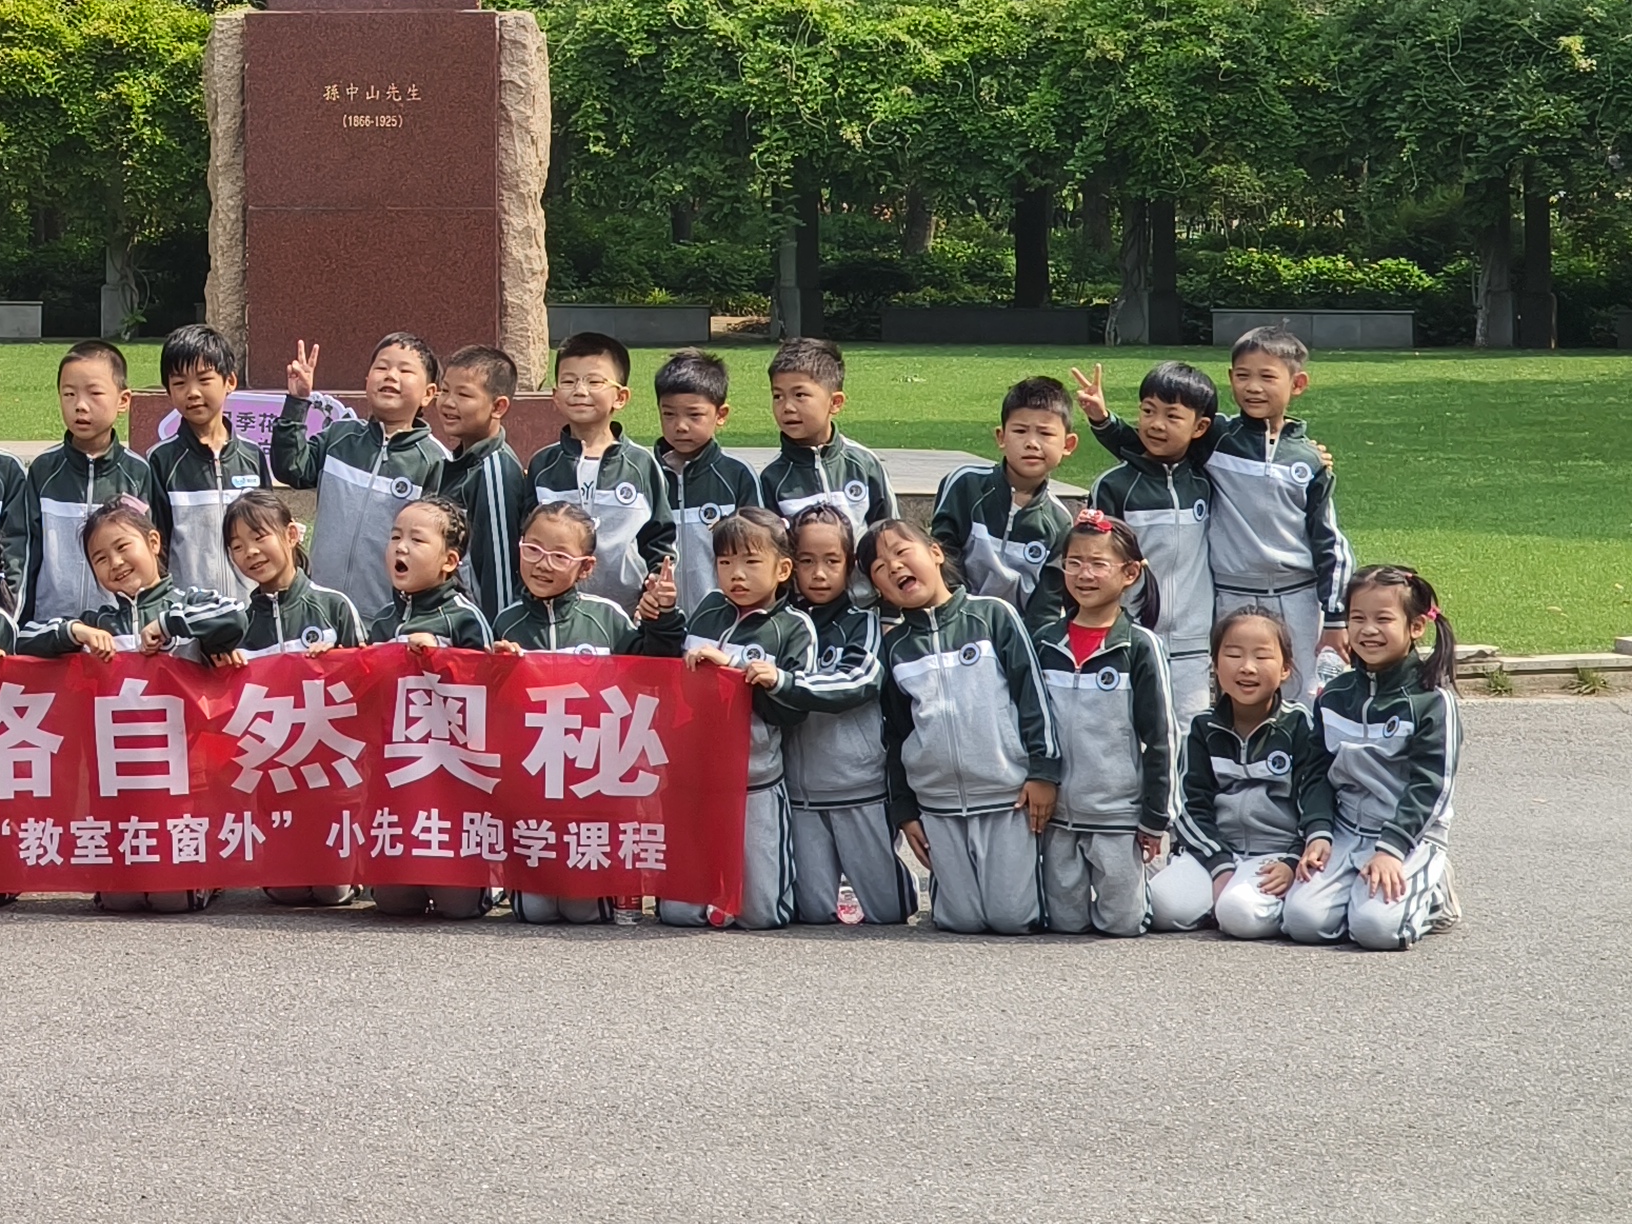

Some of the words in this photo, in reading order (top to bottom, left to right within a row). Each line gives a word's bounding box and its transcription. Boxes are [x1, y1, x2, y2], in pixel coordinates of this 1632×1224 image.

[323, 82, 422, 102] 孫中山先生
[342, 114, 404, 128] (1866-1925)
[222, 411, 277, 433] 季花
